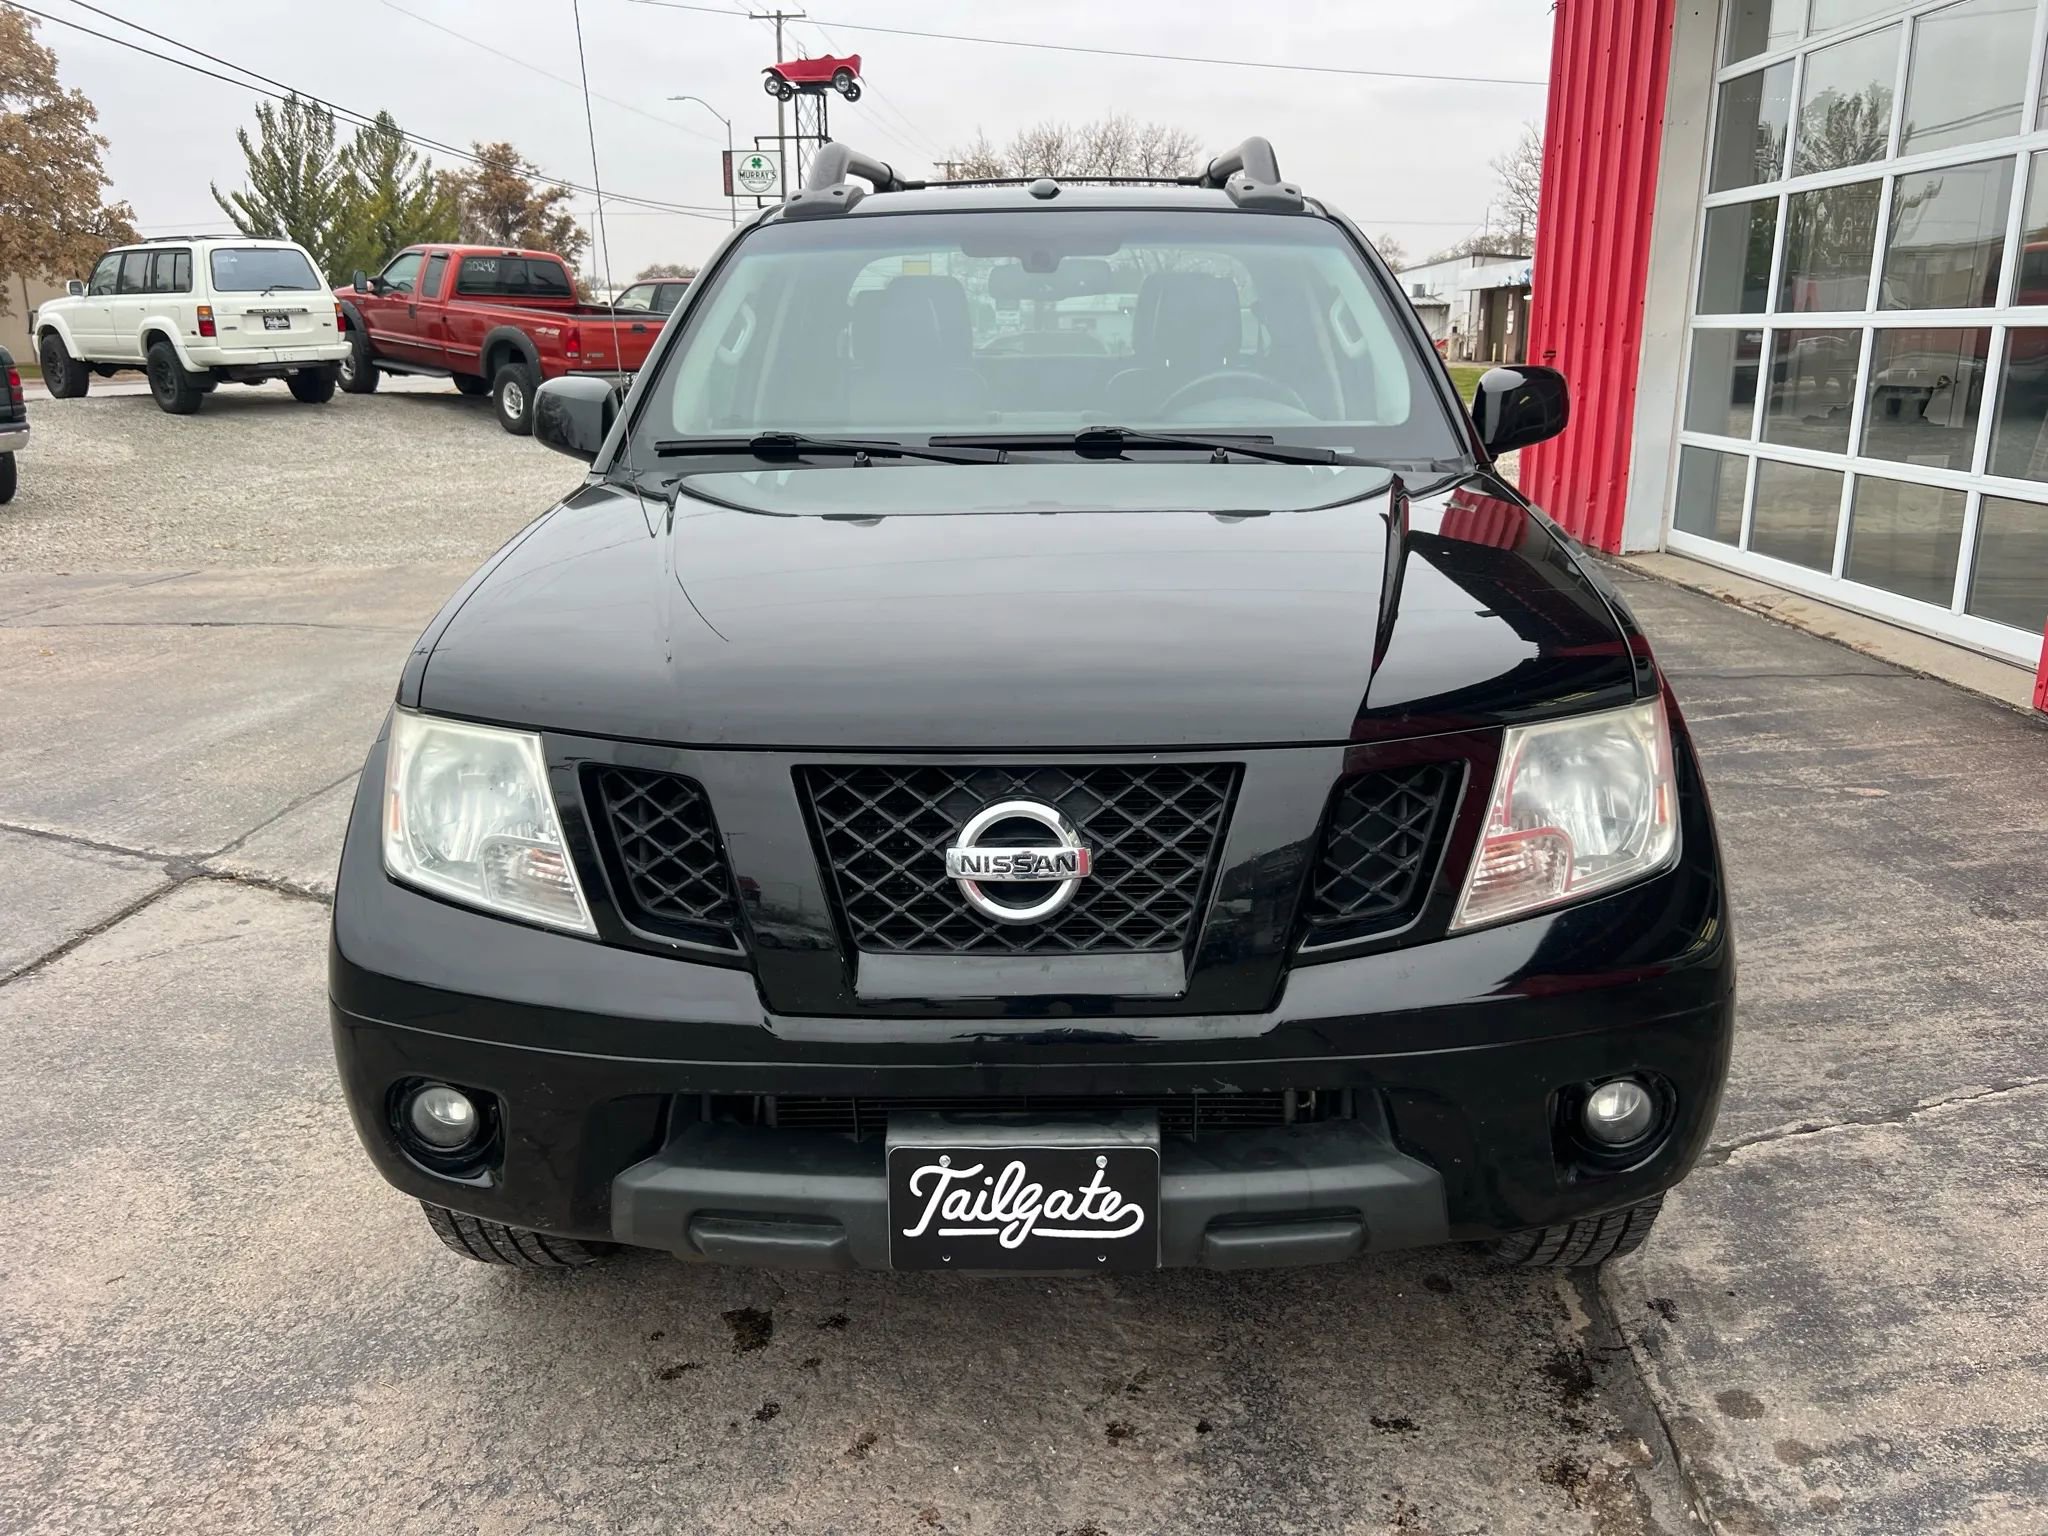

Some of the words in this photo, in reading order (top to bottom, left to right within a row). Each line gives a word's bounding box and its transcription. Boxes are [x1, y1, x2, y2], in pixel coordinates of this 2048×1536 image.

[739, 170, 777, 180] MURRAY'S
[960, 855, 1076, 874] NISSAN
[902, 1160, 1145, 1249] Tailgate
